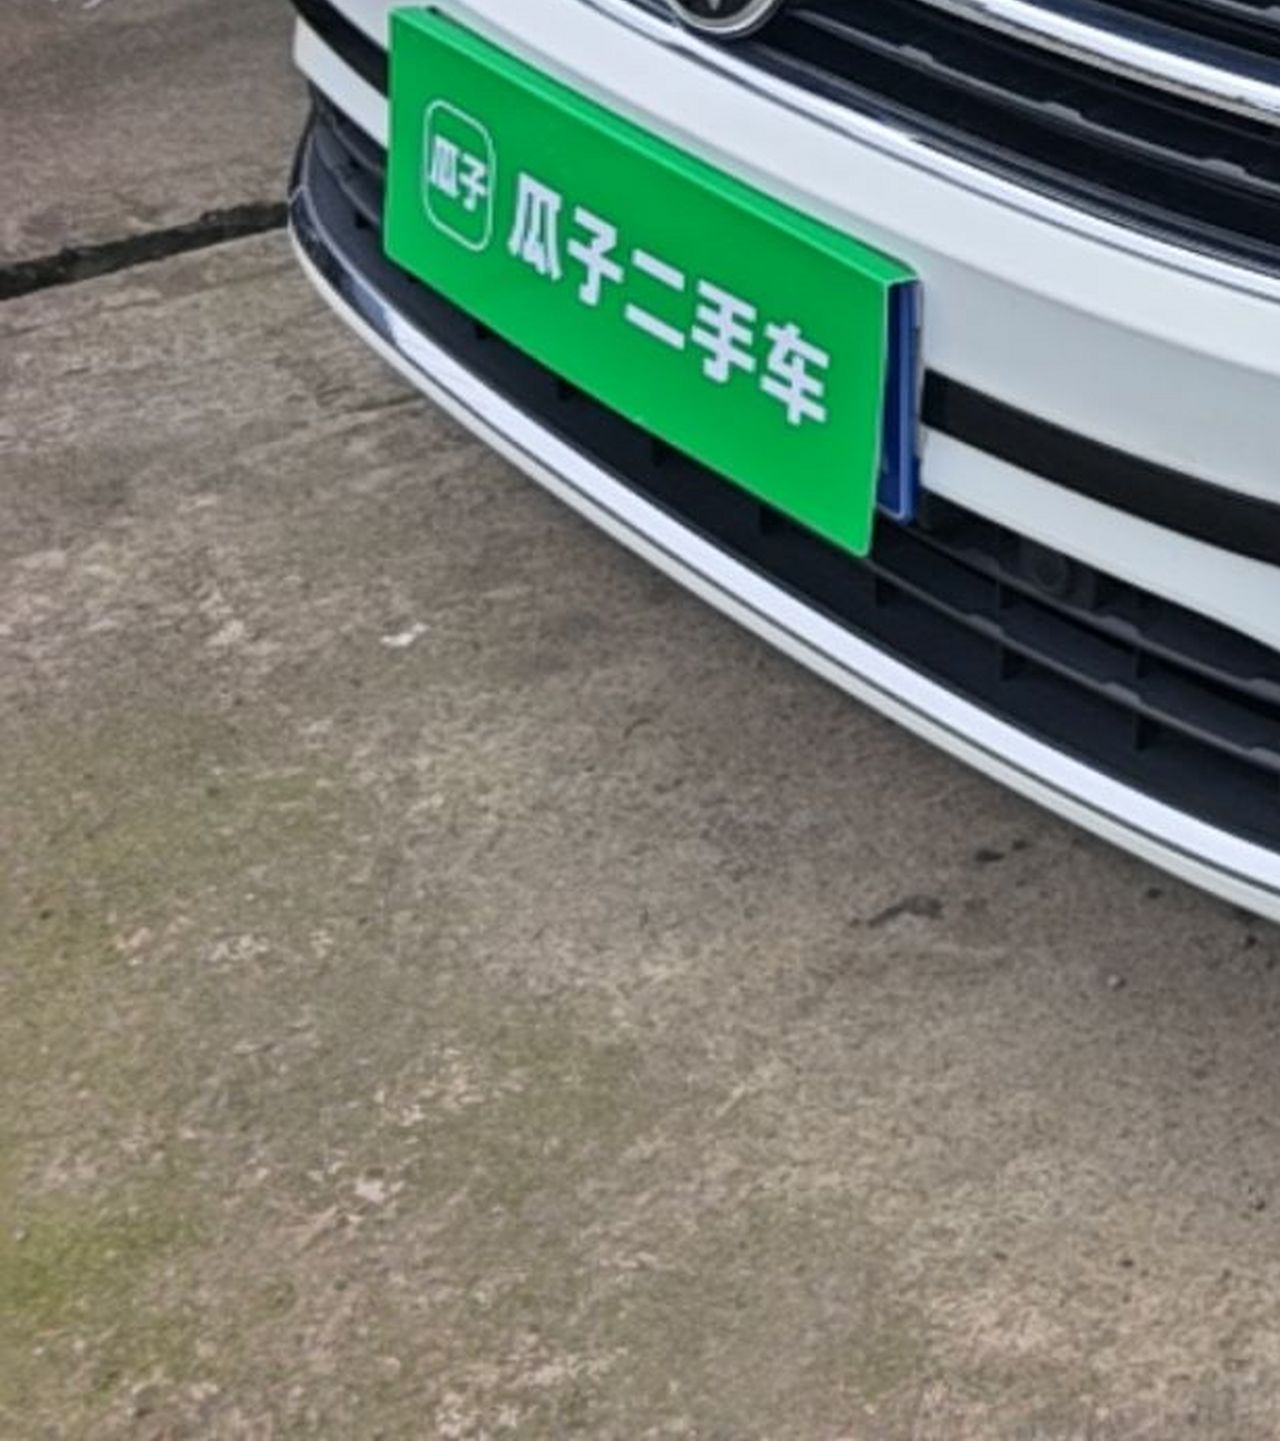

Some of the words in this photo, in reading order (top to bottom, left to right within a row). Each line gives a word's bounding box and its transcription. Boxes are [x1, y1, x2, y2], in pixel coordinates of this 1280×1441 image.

[428, 134, 488, 212] 瓜子
[507, 170, 831, 426] 瓜子二手车
